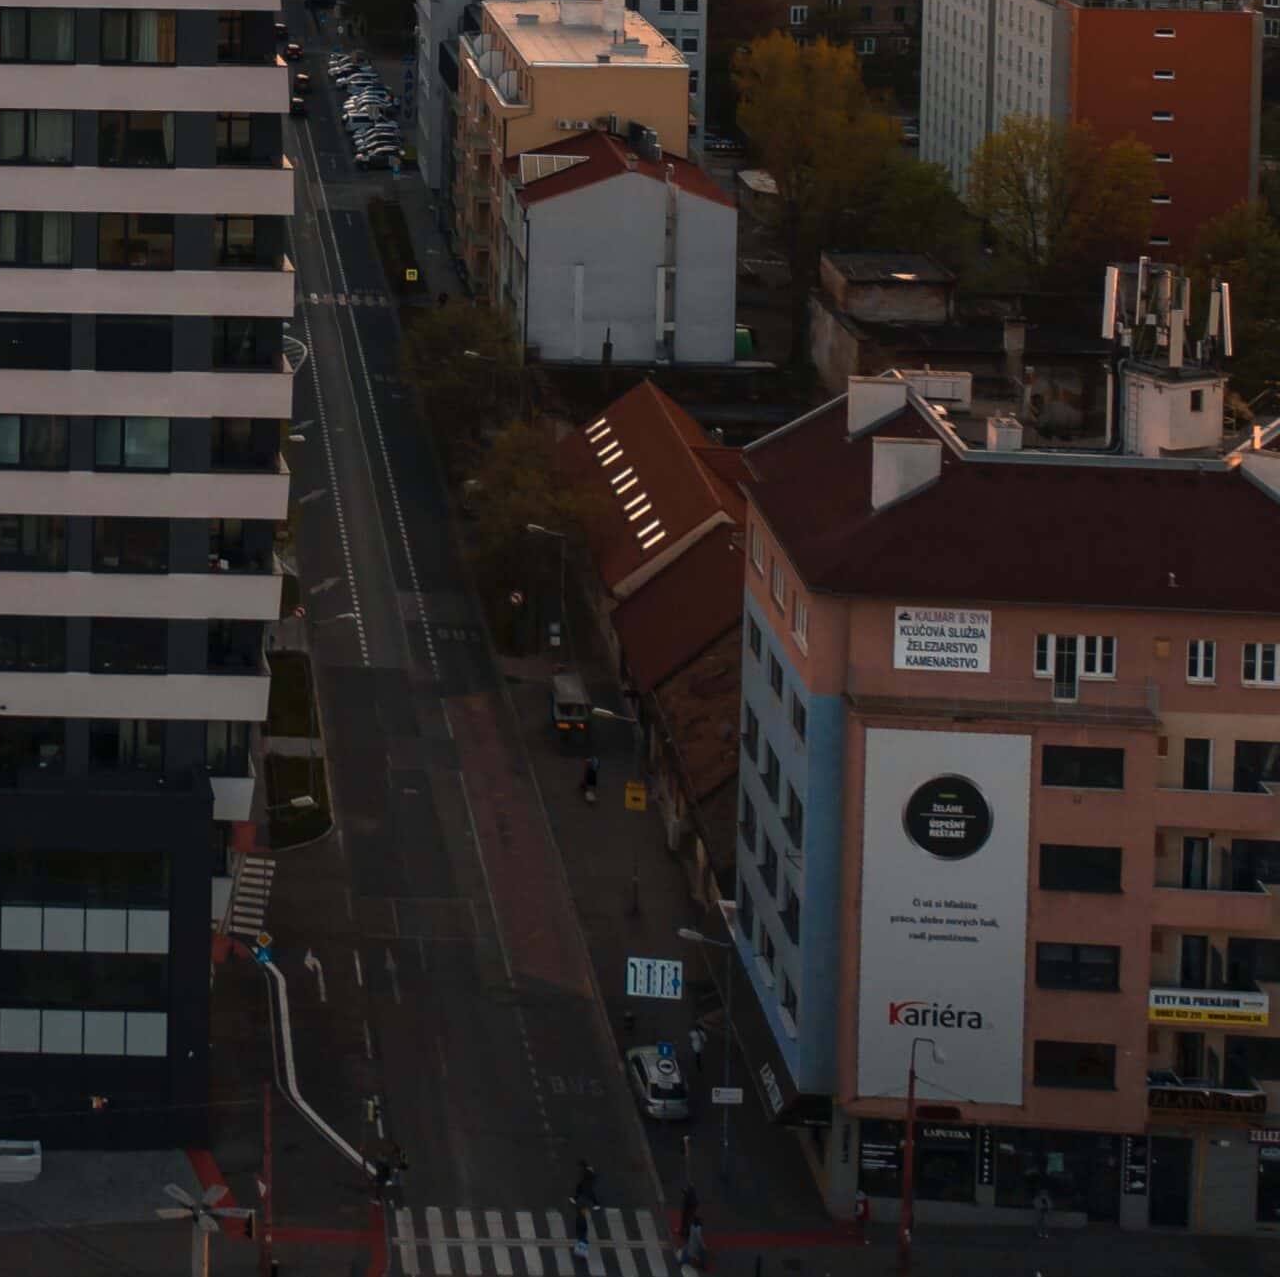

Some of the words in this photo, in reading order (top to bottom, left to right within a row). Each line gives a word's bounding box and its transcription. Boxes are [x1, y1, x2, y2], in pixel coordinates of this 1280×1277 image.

[969, 613, 989, 624] SYN
[948, 626, 986, 639] SLUŽBA
[889, 1001, 982, 1029] Kariéra
